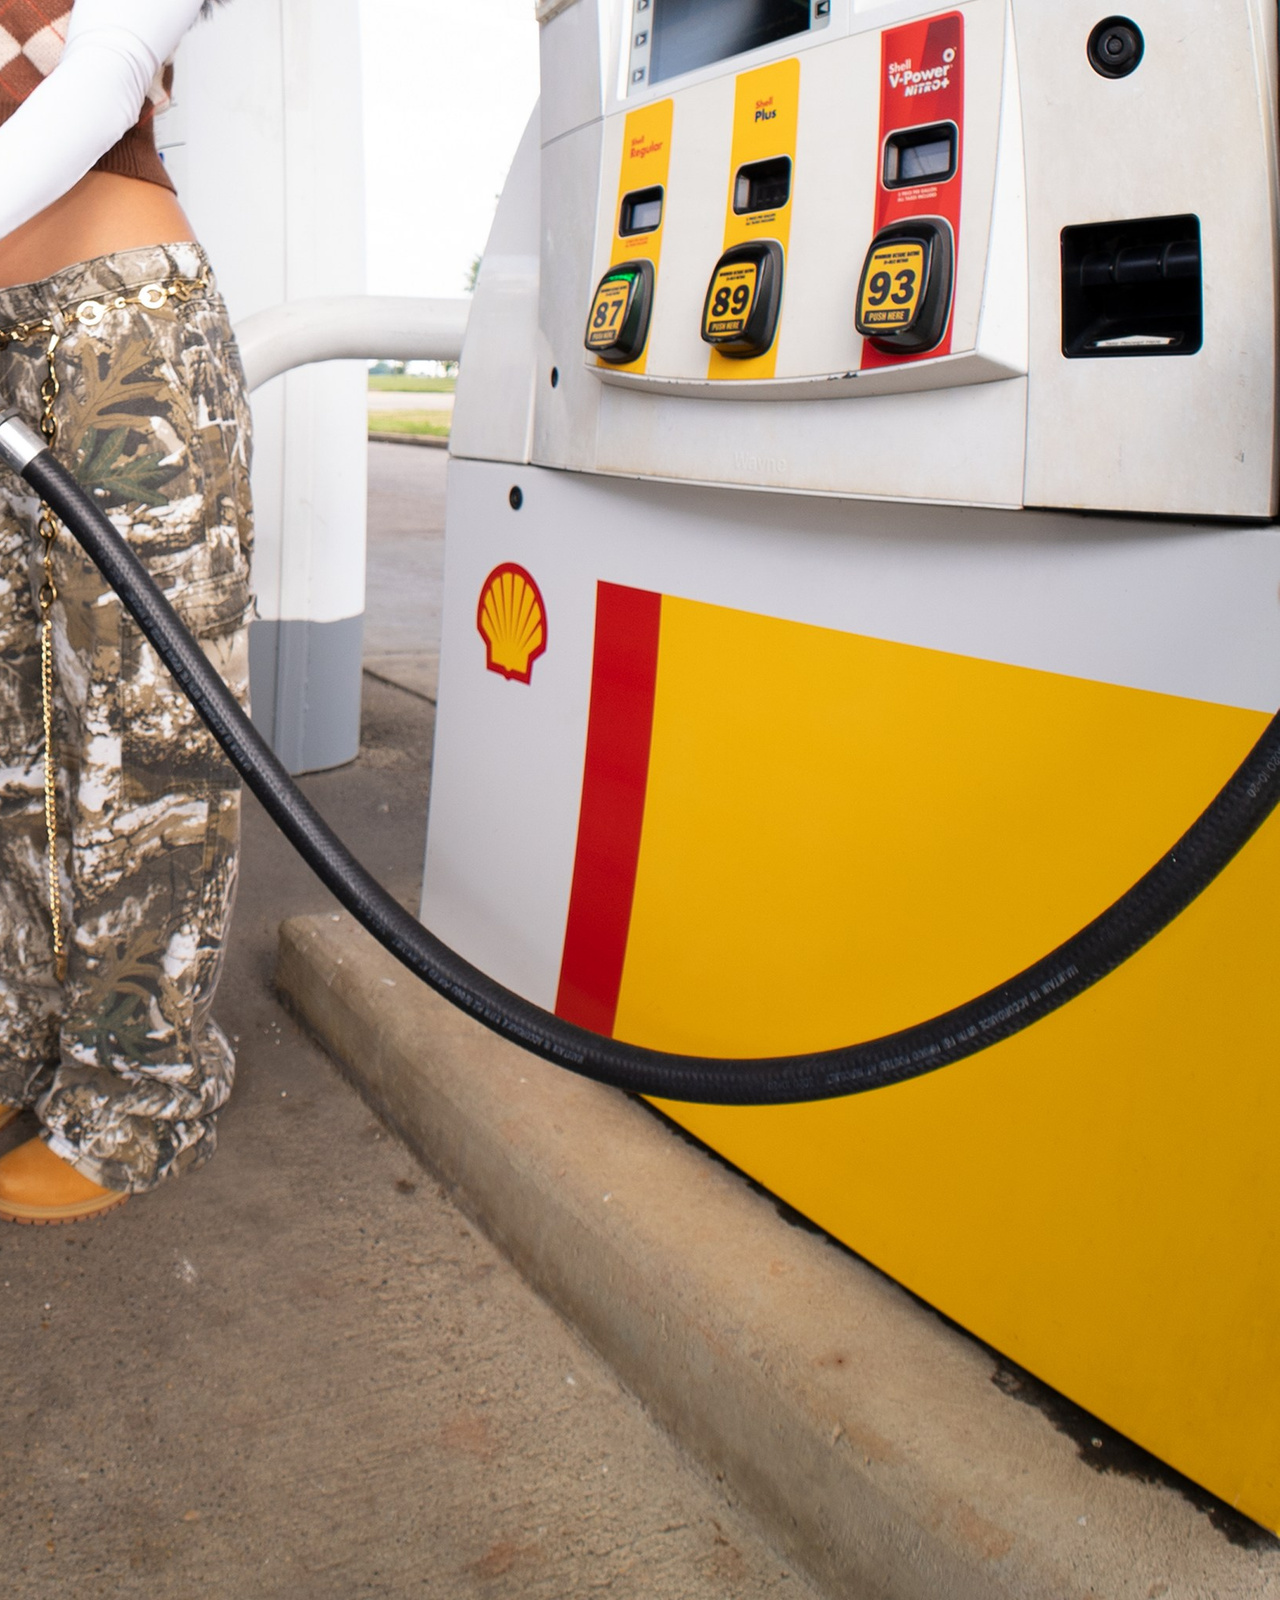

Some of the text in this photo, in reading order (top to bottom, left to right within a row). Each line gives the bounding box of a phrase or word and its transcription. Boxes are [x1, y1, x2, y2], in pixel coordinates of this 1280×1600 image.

[888, 58, 912, 75] Shell
[889, 64, 951, 89] V-Power
[755, 96, 774, 110] Shell
[754, 108, 777, 123] Plus
[629, 140, 664, 159] Regular
[868, 269, 916, 307] 93
[711, 284, 750, 317] 89
[593, 299, 624, 328] 87
[869, 310, 905, 322] PUSH HERE
[733, 450, 788, 474] Wayne
